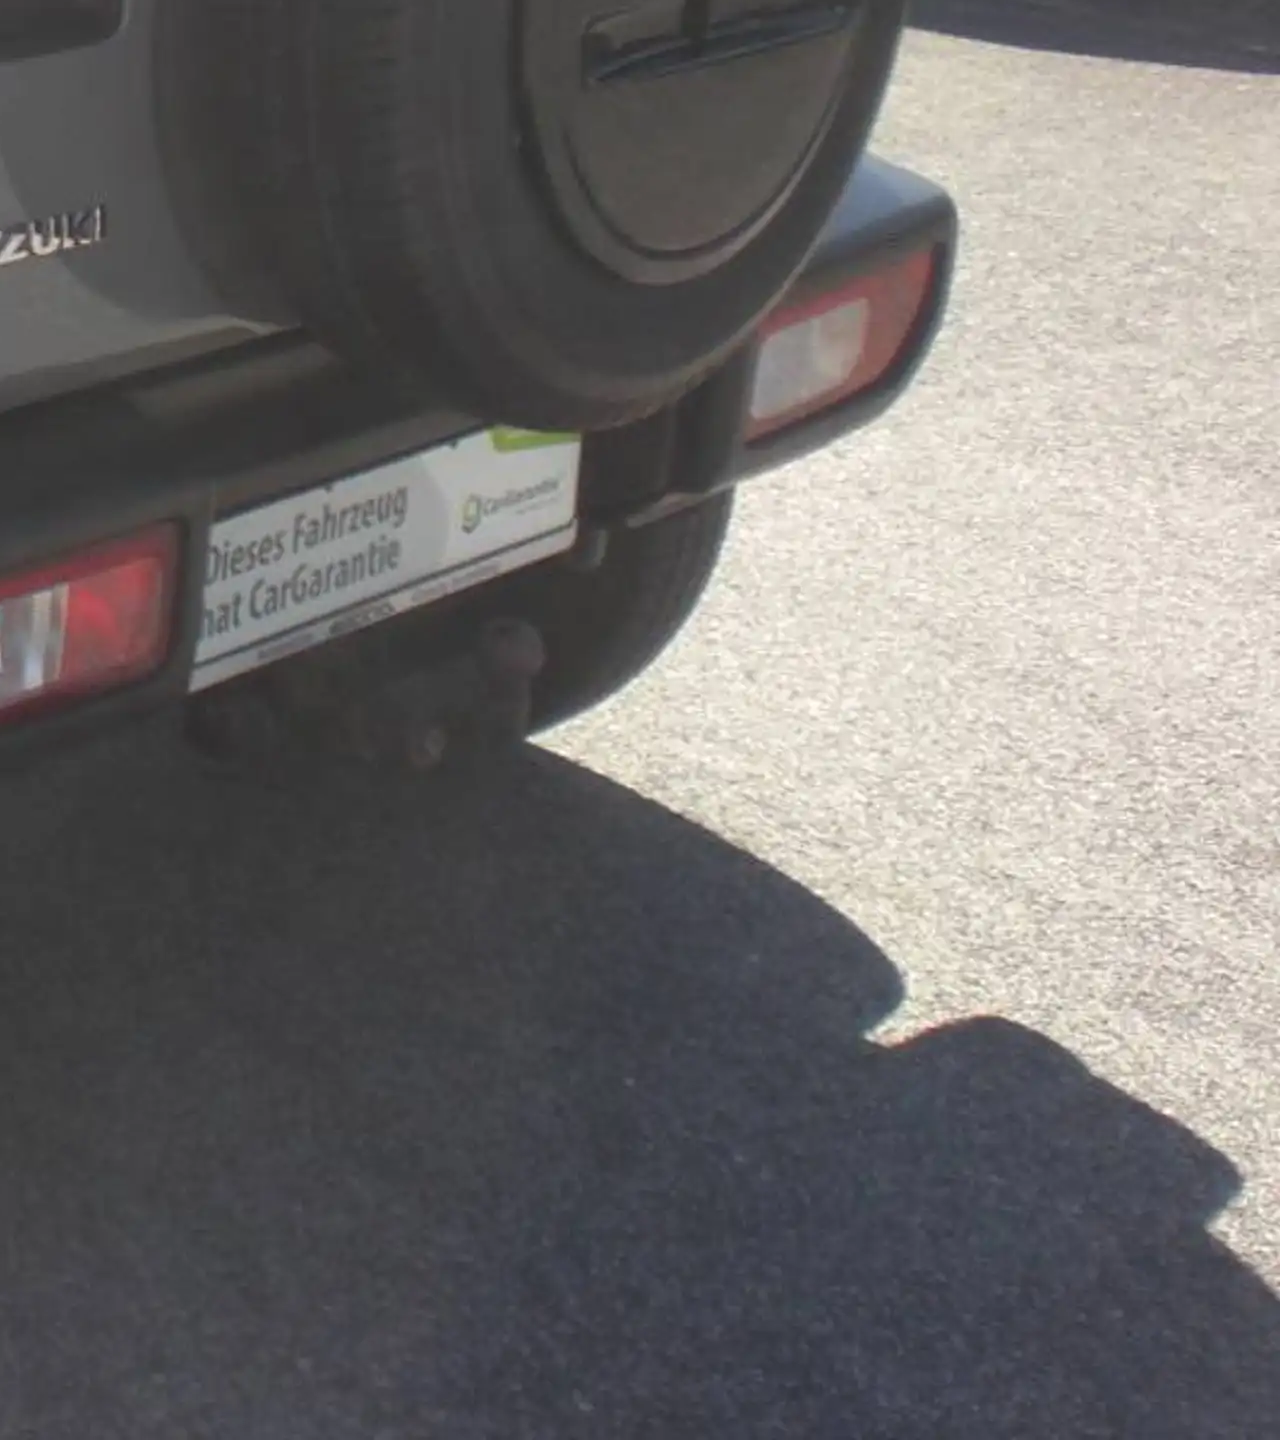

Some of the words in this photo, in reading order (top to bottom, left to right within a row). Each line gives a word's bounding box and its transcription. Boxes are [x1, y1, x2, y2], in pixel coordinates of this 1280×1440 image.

[205, 528, 287, 586] Dieses
[292, 485, 409, 555] Fahrzeug
[248, 533, 402, 620] CarGarantie
